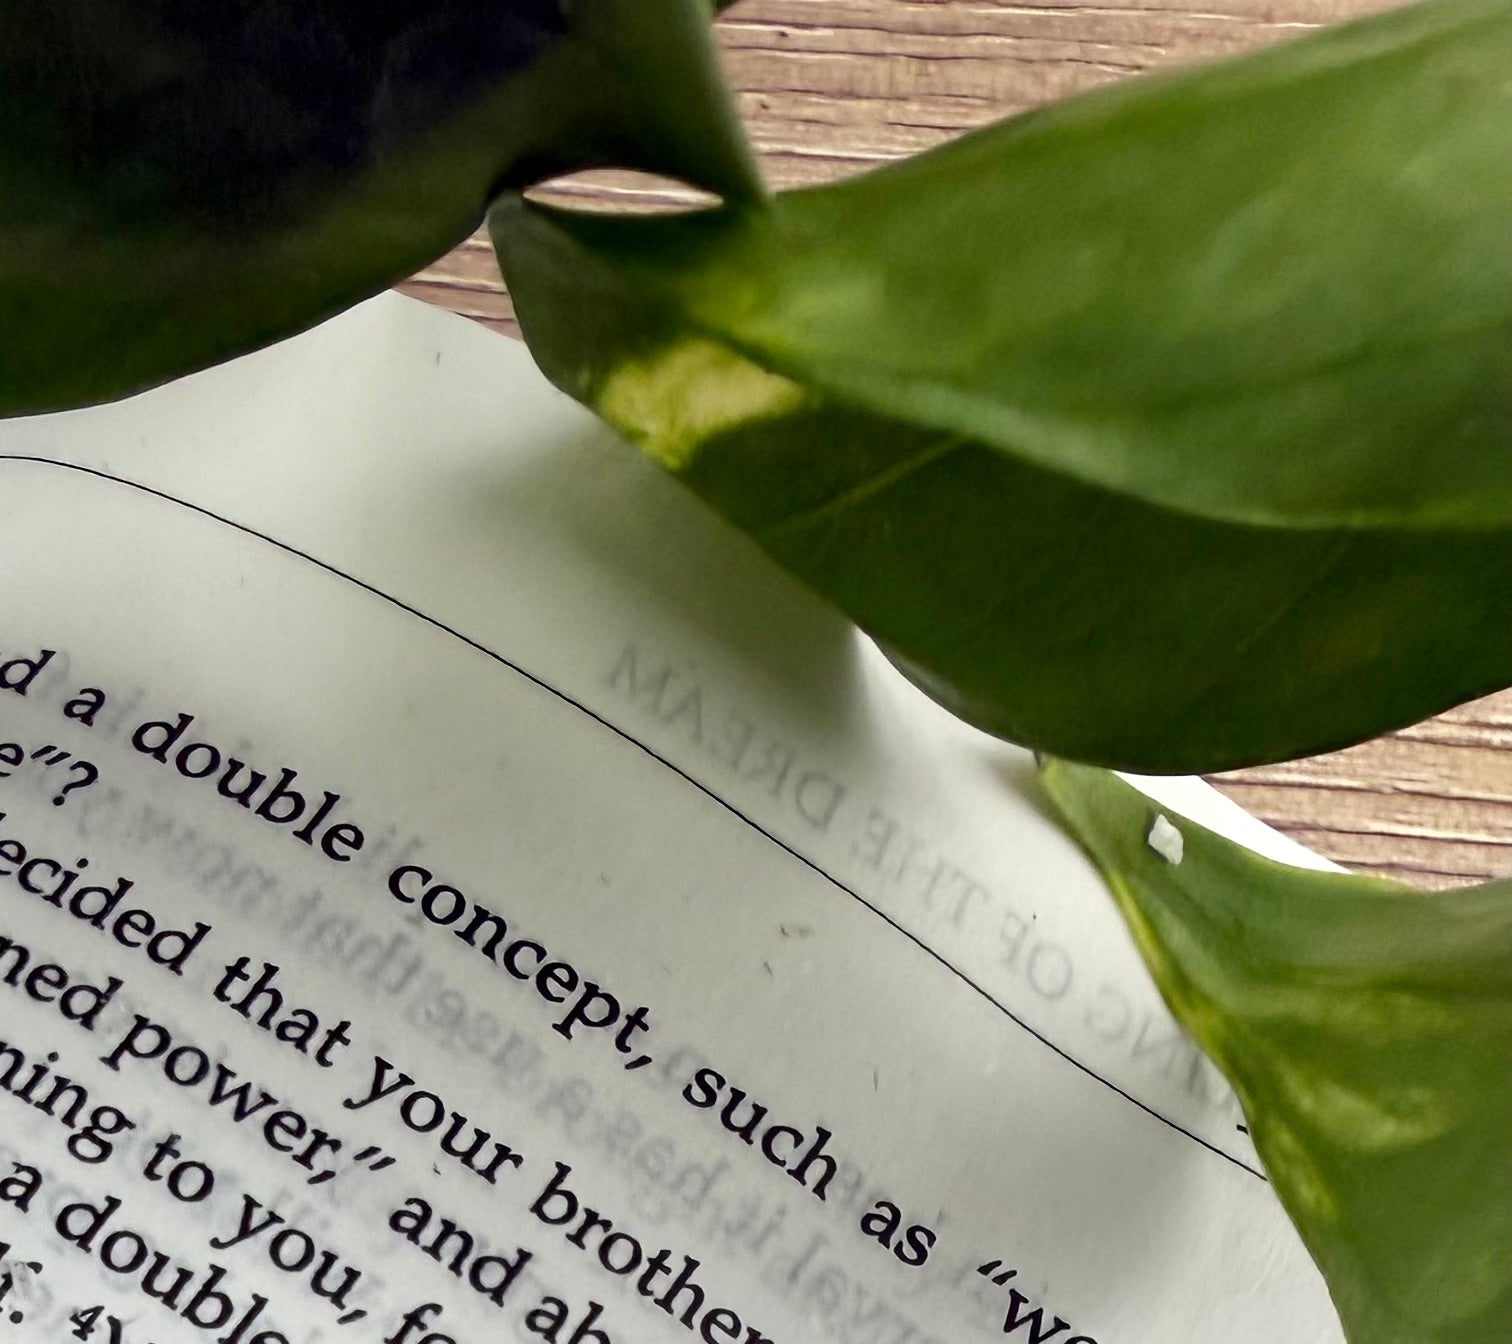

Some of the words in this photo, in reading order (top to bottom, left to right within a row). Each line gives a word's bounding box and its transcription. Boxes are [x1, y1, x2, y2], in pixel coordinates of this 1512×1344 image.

[64, 688, 105, 727] a
[132, 713, 364, 861] double
[387, 862, 654, 1071] concept,
[683, 1068, 837, 1201] such
[861, 1201, 936, 1266] as
[213, 957, 351, 1067] that
[343, 1056, 523, 1184] your
[143, 1134, 214, 1202] to
[210, 1194, 366, 1324] you,
[389, 1198, 533, 1307] and
